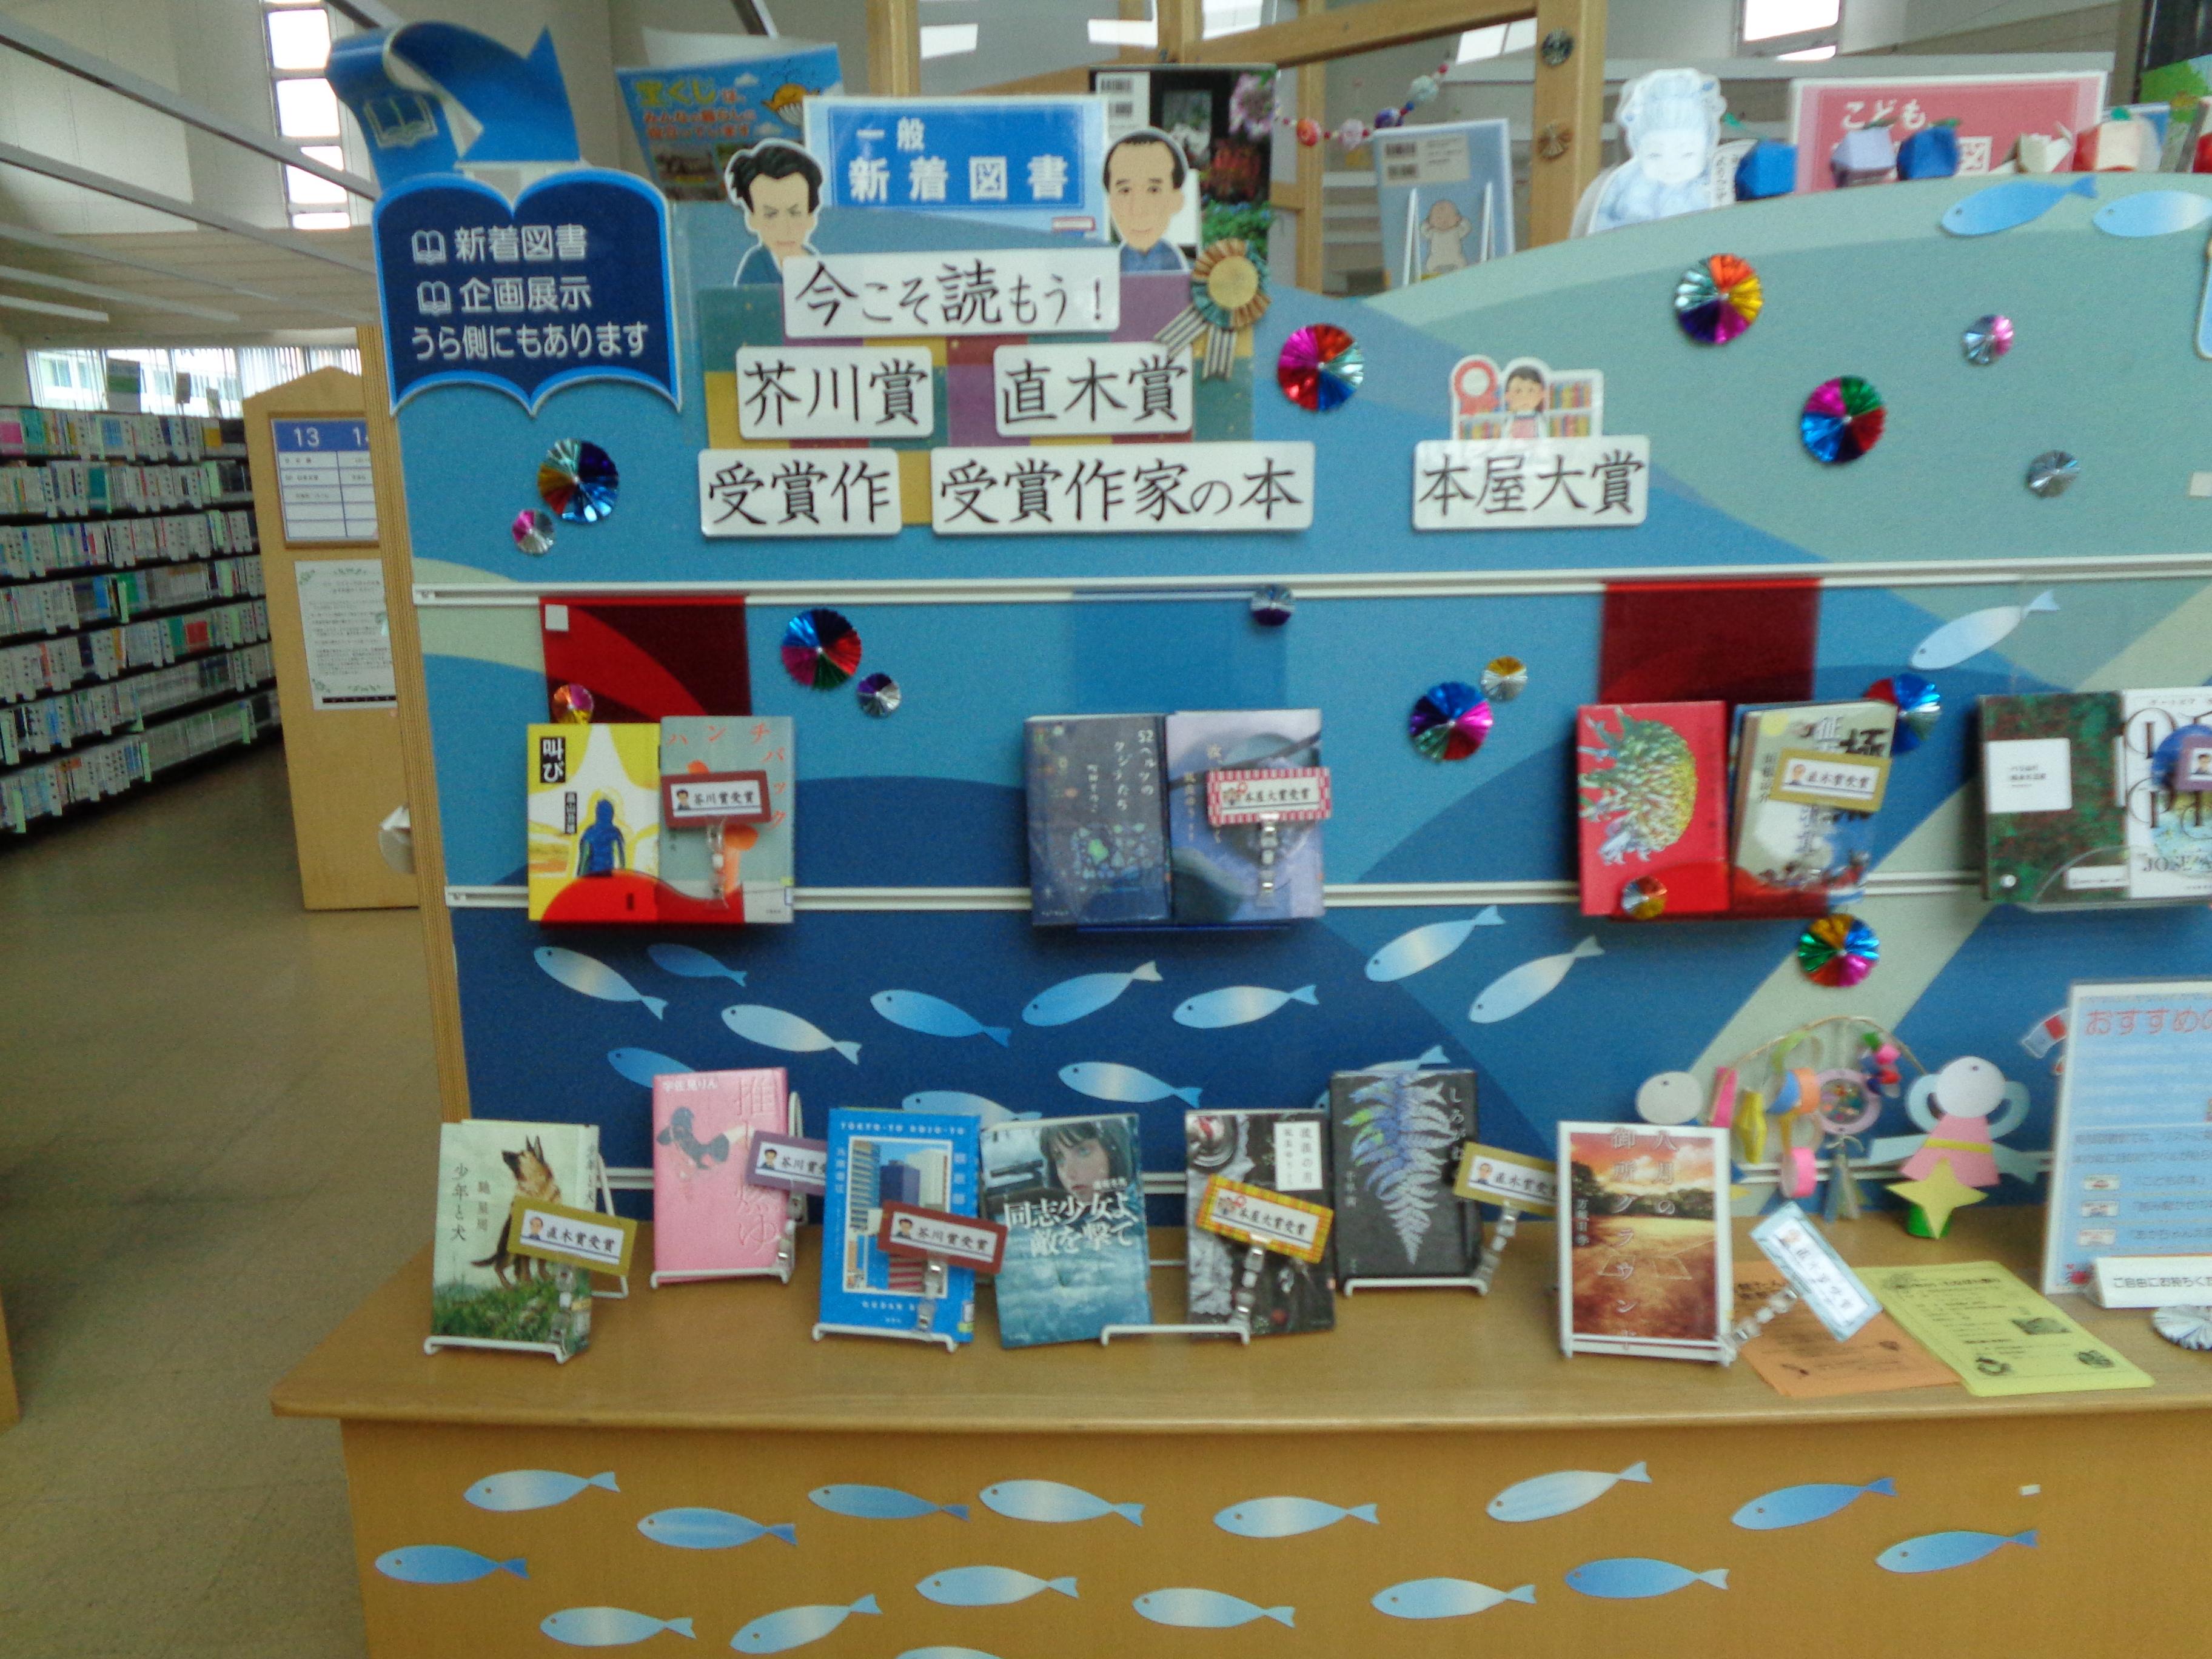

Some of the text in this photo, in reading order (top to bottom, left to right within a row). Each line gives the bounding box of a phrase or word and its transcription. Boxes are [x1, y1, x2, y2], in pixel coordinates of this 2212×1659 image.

[1841, 98, 1927, 130] こども
[856, 116, 925, 152] 一般
[848, 154, 1069, 203] 新着図書
[454, 224, 588, 262] 新着図書
[459, 275, 592, 313] 企画展示
[412, 321, 648, 360] うら側にもあります
[743, 360, 928, 427] 芥川賞
[1002, 358, 1187, 423] 直木賞
[293, 426, 320, 447] 13
[352, 426, 369, 447] 1
[708, 461, 891, 525] 受賞作
[940, 457, 1303, 523] 受賞作家の本
[1419, 449, 1645, 517] 本屋大賞
[542, 737, 564, 783] 叫び
[694, 790, 754, 806] 芥川賞受賞
[451, 1162, 469, 1242] 少年と犬
[547, 1226, 615, 1254] 直木賞受賞
[917, 1226, 989, 1251] 芥川賞受賞
